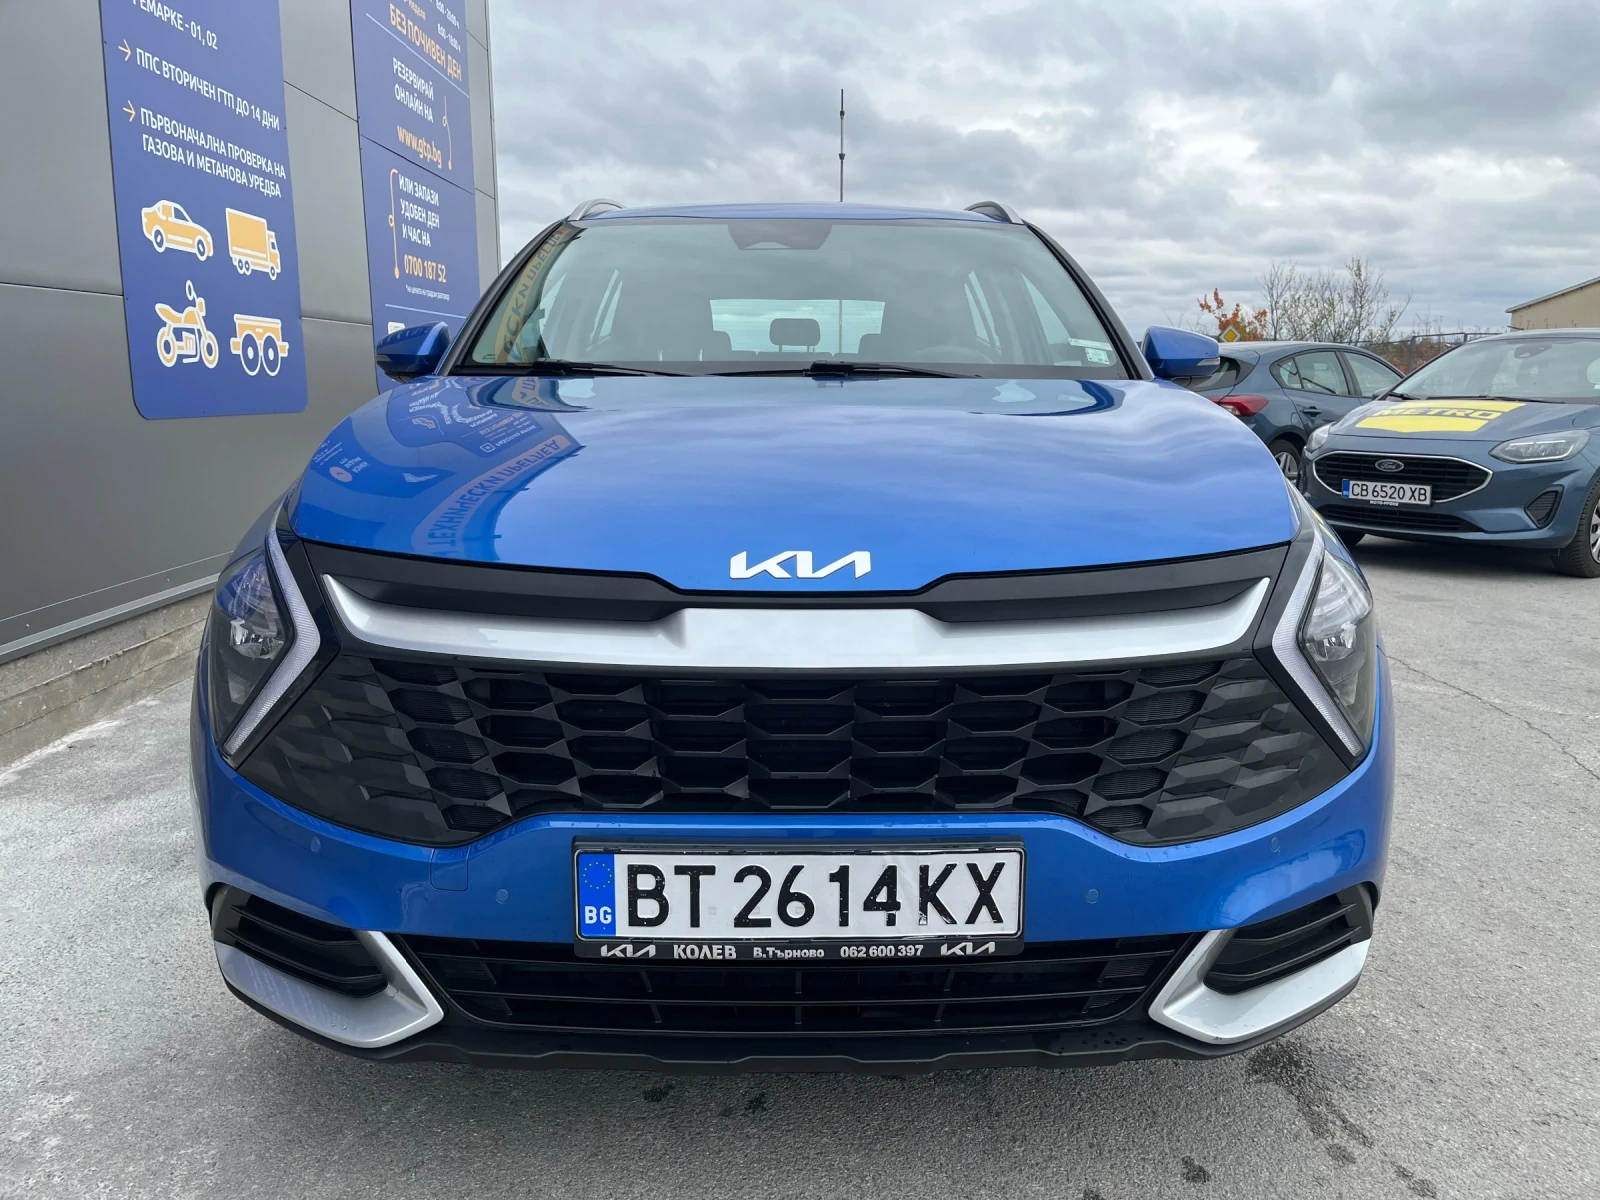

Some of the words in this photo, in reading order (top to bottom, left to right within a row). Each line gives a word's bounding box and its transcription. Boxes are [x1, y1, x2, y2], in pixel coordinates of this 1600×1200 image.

[132, 0, 184, 31] ЕМАРКЕ
[389, 2, 407, 35] БЕЗ
[407, 19, 446, 69] ПОЧИВЕН
[446, 54, 462, 82] ДЕН
[136, 47, 161, 75] ППС
[162, 60, 216, 101] ВТОРИЧЕН
[217, 87, 235, 110] ГТП
[236, 99, 250, 117] ДО
[250, 104, 261, 122] 14
[261, 110, 281, 131] ДНИ
[392, 57, 435, 102] РЕЗЕРВИРАЙ
[394, 83, 424, 117] ОНЛАЙН
[424, 103, 434, 124] НА
[140, 107, 228, 157] ПЪРВОНАЧАЛНА
[227, 142, 274, 174] ПРОВЕРКА
[274, 161, 287, 180] НА
[396, 125, 443, 170] www.gtp.bg
[142, 133, 186, 166] ГАЗОВА
[186, 150, 196, 168] И
[196, 154, 249, 187] МЕТАНОВА
[249, 172, 283, 199] УРЕДБА
[398, 173, 414, 195] ИЛИ
[414, 181, 440, 207] ЗАПАЗИ
[400, 198, 427, 224] УДОБЕН
[427, 210, 440, 229] ДЕН
[402, 223, 407, 240] И
[407, 226, 422, 245] ЧАС
[421, 231, 432, 248] НА
[404, 254, 423, 277] 0700
[424, 260, 436, 281] 187
[437, 263, 447, 283] 52
[1372, 408, 1503, 420] METRO
[1371, 484, 1406, 500] 6520
[732, 863, 902, 929] 2614
[584, 905, 613, 925] BG
[672, 944, 737, 960] КОЛЕВ
[840, 946, 867, 959] 062
[868, 945, 896, 958] 600
[897, 944, 924, 957] 397
